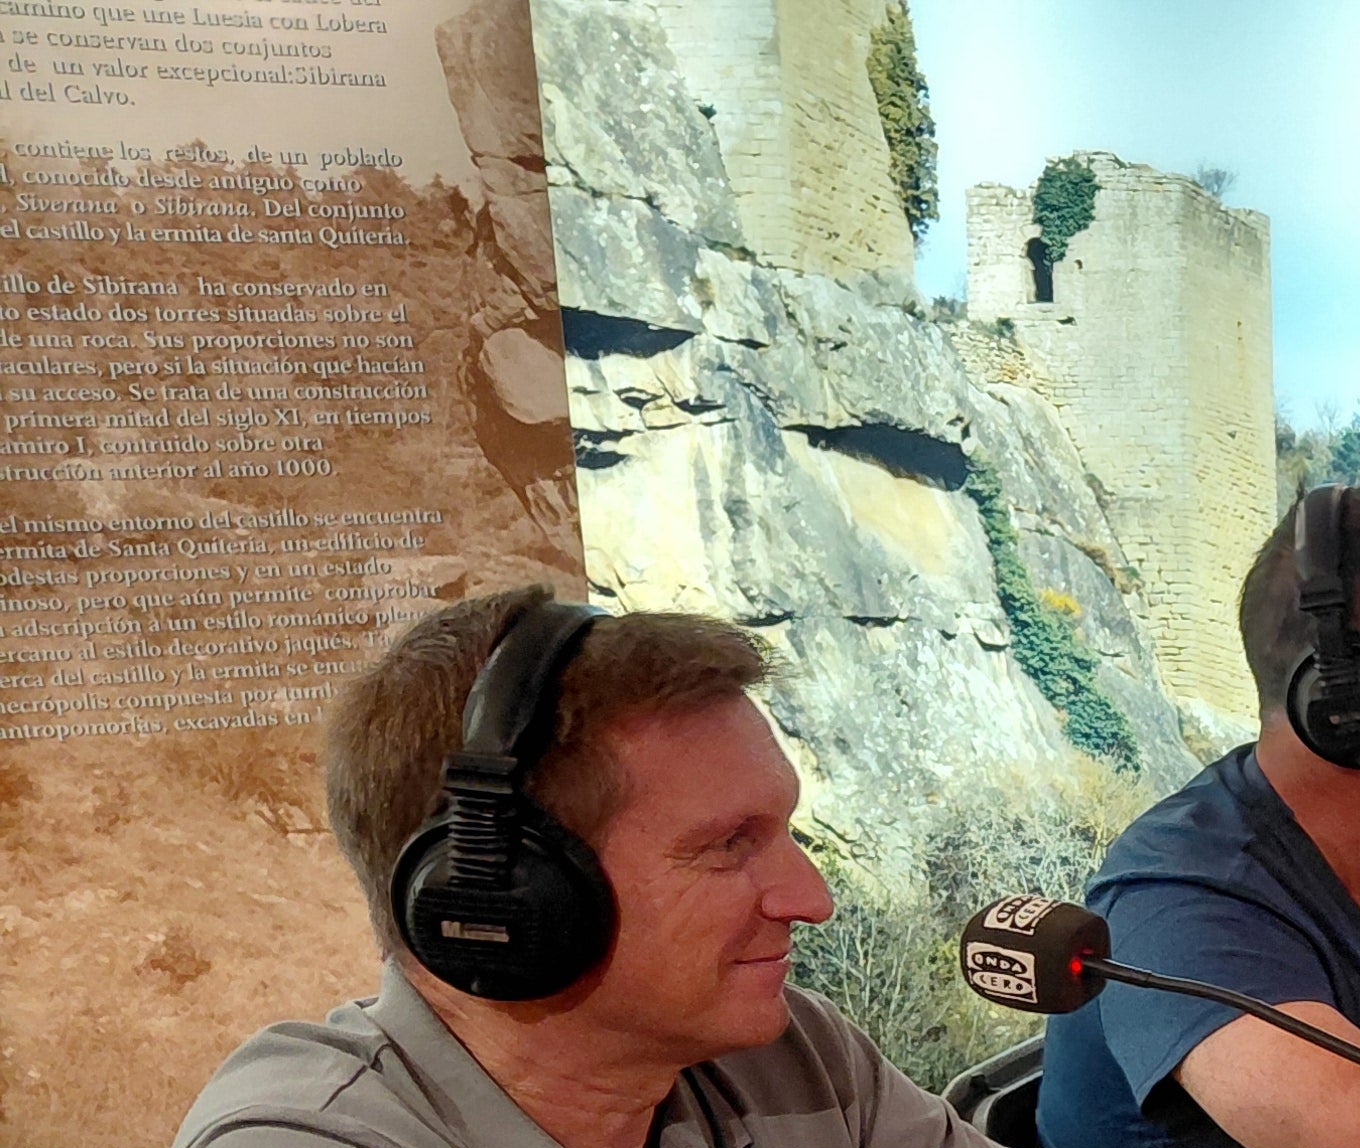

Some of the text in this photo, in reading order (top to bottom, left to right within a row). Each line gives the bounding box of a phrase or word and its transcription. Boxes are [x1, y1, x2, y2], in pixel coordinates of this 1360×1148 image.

[93, 7, 135, 26] que
[143, 8, 185, 24] une
[192, 7, 263, 28] Luesia
[269, 15, 309, 31] con
[315, 13, 387, 33] Lobera
[47, 32, 332, 60] conservan dos conjuntos
[92, 58, 148, 78] valor
[20, 82, 136, 105] del Calvo.
[15, 140, 114, 160] contiene
[119, 141, 151, 161] los
[320, 148, 403, 171] poblado
[22, 165, 363, 196] conocido desde antiguo como
[16, 192, 406, 223] Siverana Sibirana. Del conjunto
[26, 220, 411, 249] castillo ermita santa Quiteria.
[83, 276, 357, 297] Sibirana conservado
[27, 303, 383, 323] estado dos torres situadas sobre
[144, 330, 337, 353] Sus proporciones
[211, 354, 425, 379] situación que hacían
[294, 380, 429, 400] construcción
[5, 407, 432, 434] primera mitad siglo XI, tiempos
[101, 432, 324, 455] contruido sobre otra
[109, 461, 199, 481] anterior
[229, 459, 269, 478] año
[237, 508, 443, 528] castillo encuentra
[107, 530, 394, 558] Santa Quiteria, edificio
[229, 580, 441, 609] permite comprobar
[168, 637, 278, 656] decorativo
[974, 953, 1023, 973] ONDA
[980, 974, 1024, 992] CERO
